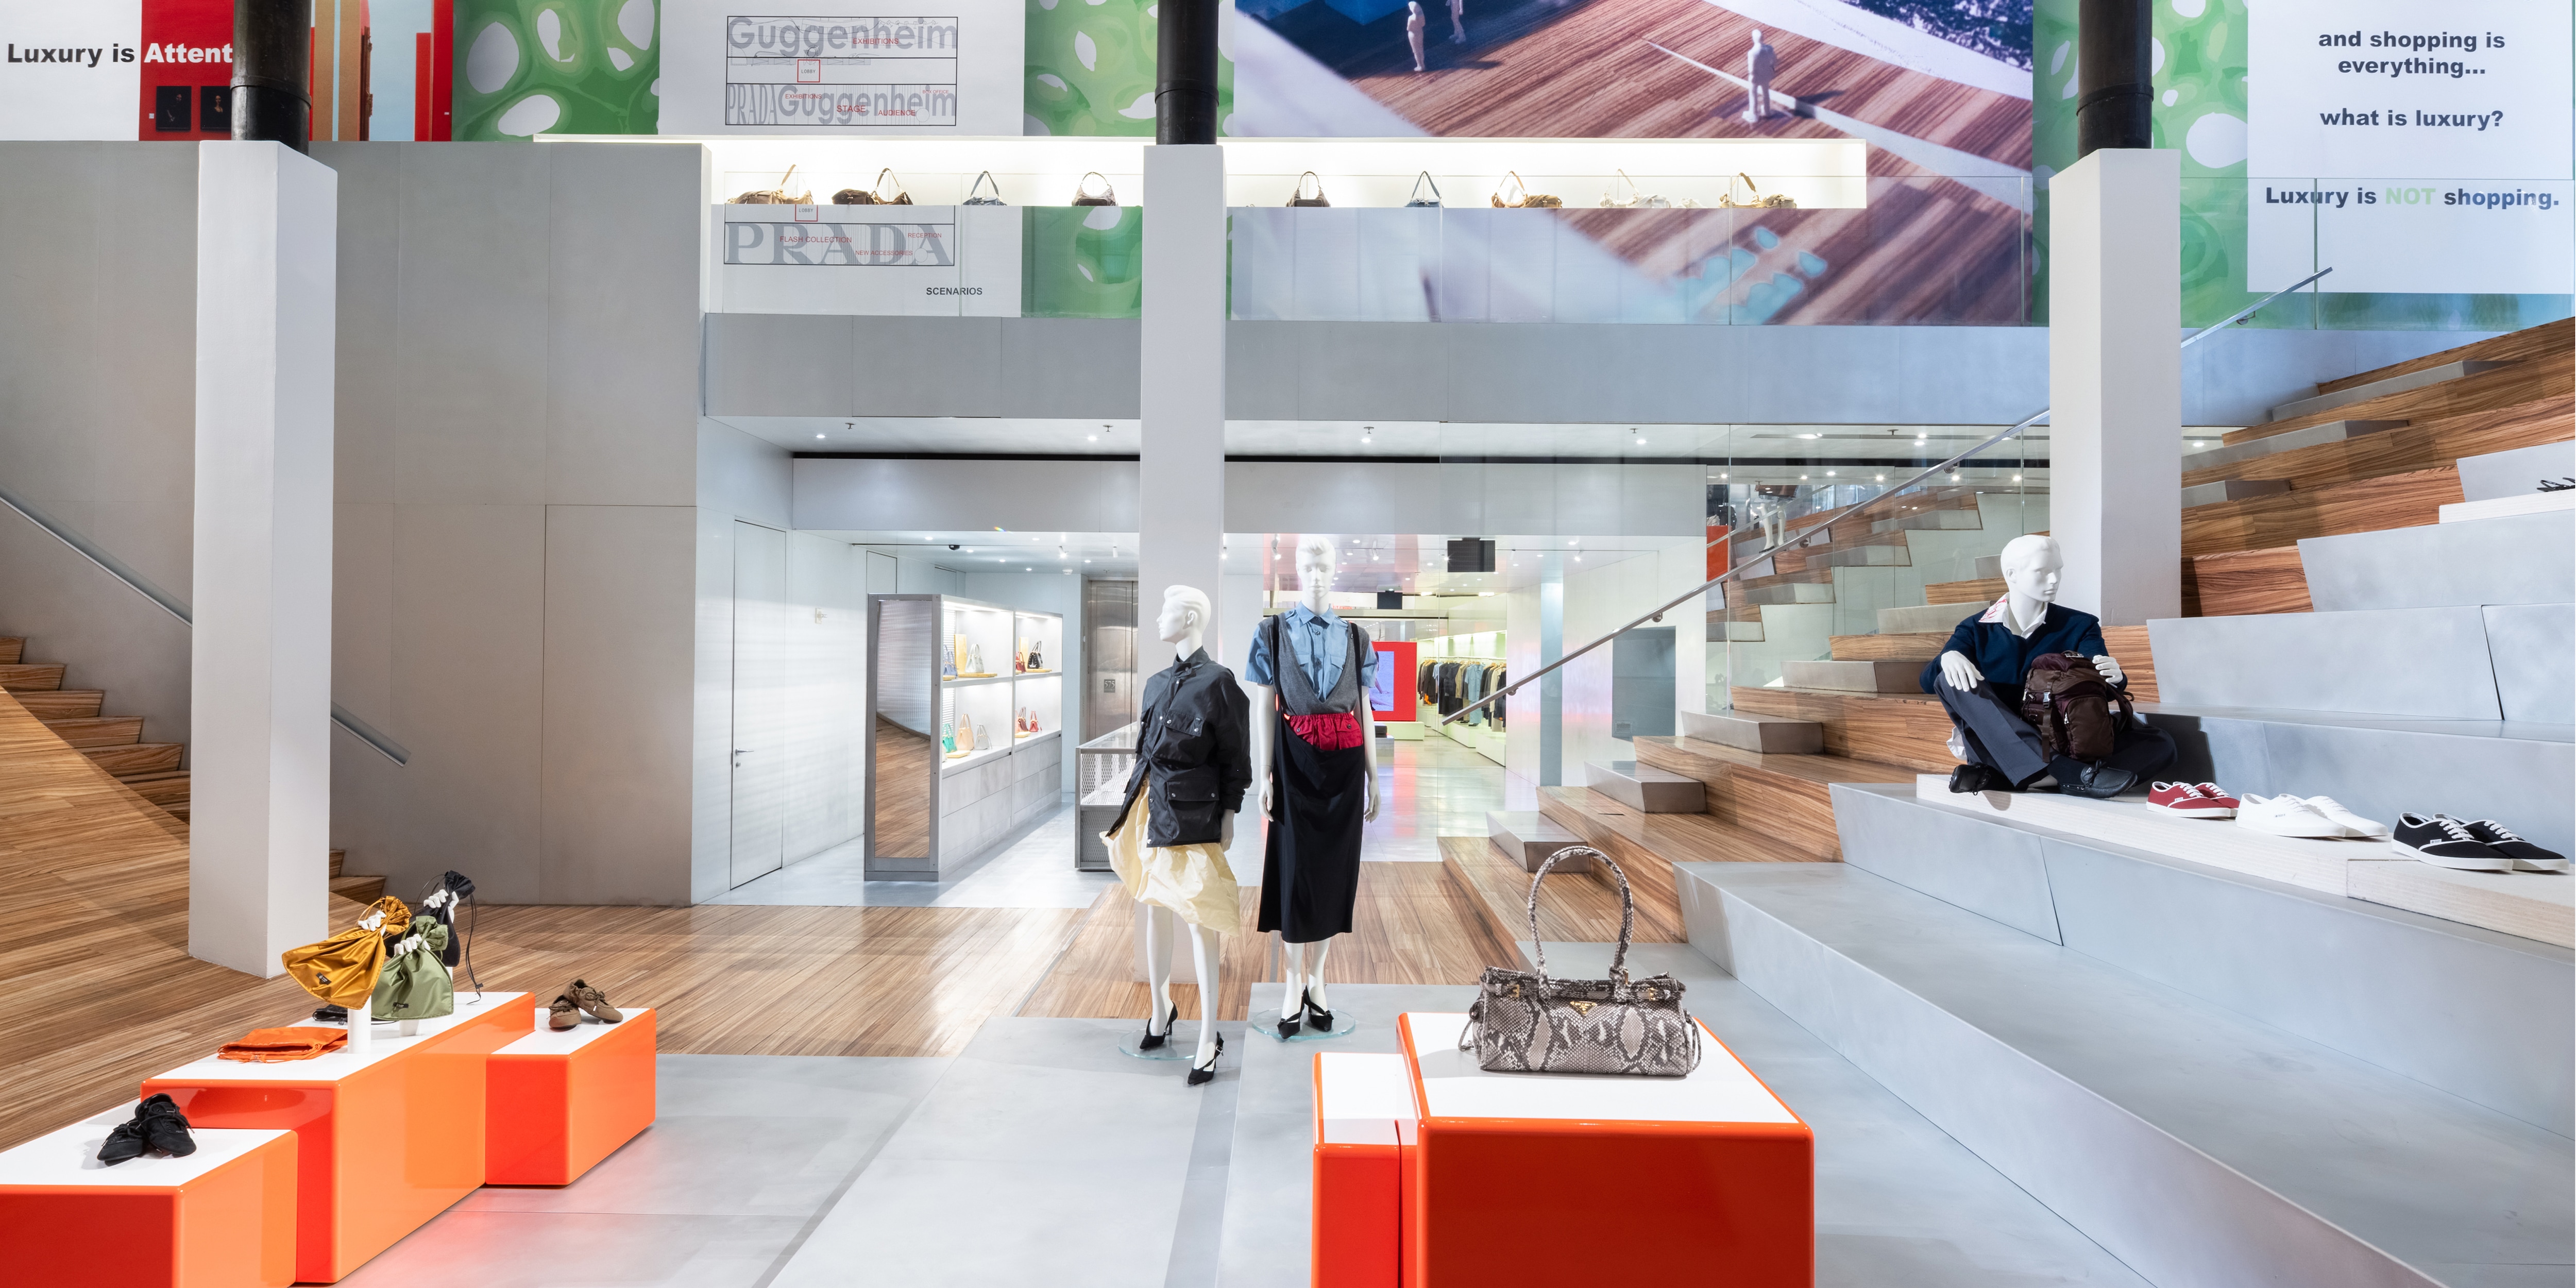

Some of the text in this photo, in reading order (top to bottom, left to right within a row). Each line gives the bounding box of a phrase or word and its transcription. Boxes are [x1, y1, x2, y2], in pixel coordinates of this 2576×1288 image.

[728, 16, 957, 57] Guggenheim
[2318, 31, 2505, 52] and shopping is
[8, 43, 233, 67] Luxury is Attent
[2338, 58, 2486, 78] everything...
[2319, 108, 2503, 131] what is luxury?
[2266, 187, 2560, 210] Luxury is NOT shopping.
[725, 223, 954, 265] PRADA
[926, 287, 982, 296] SCENARIOS
